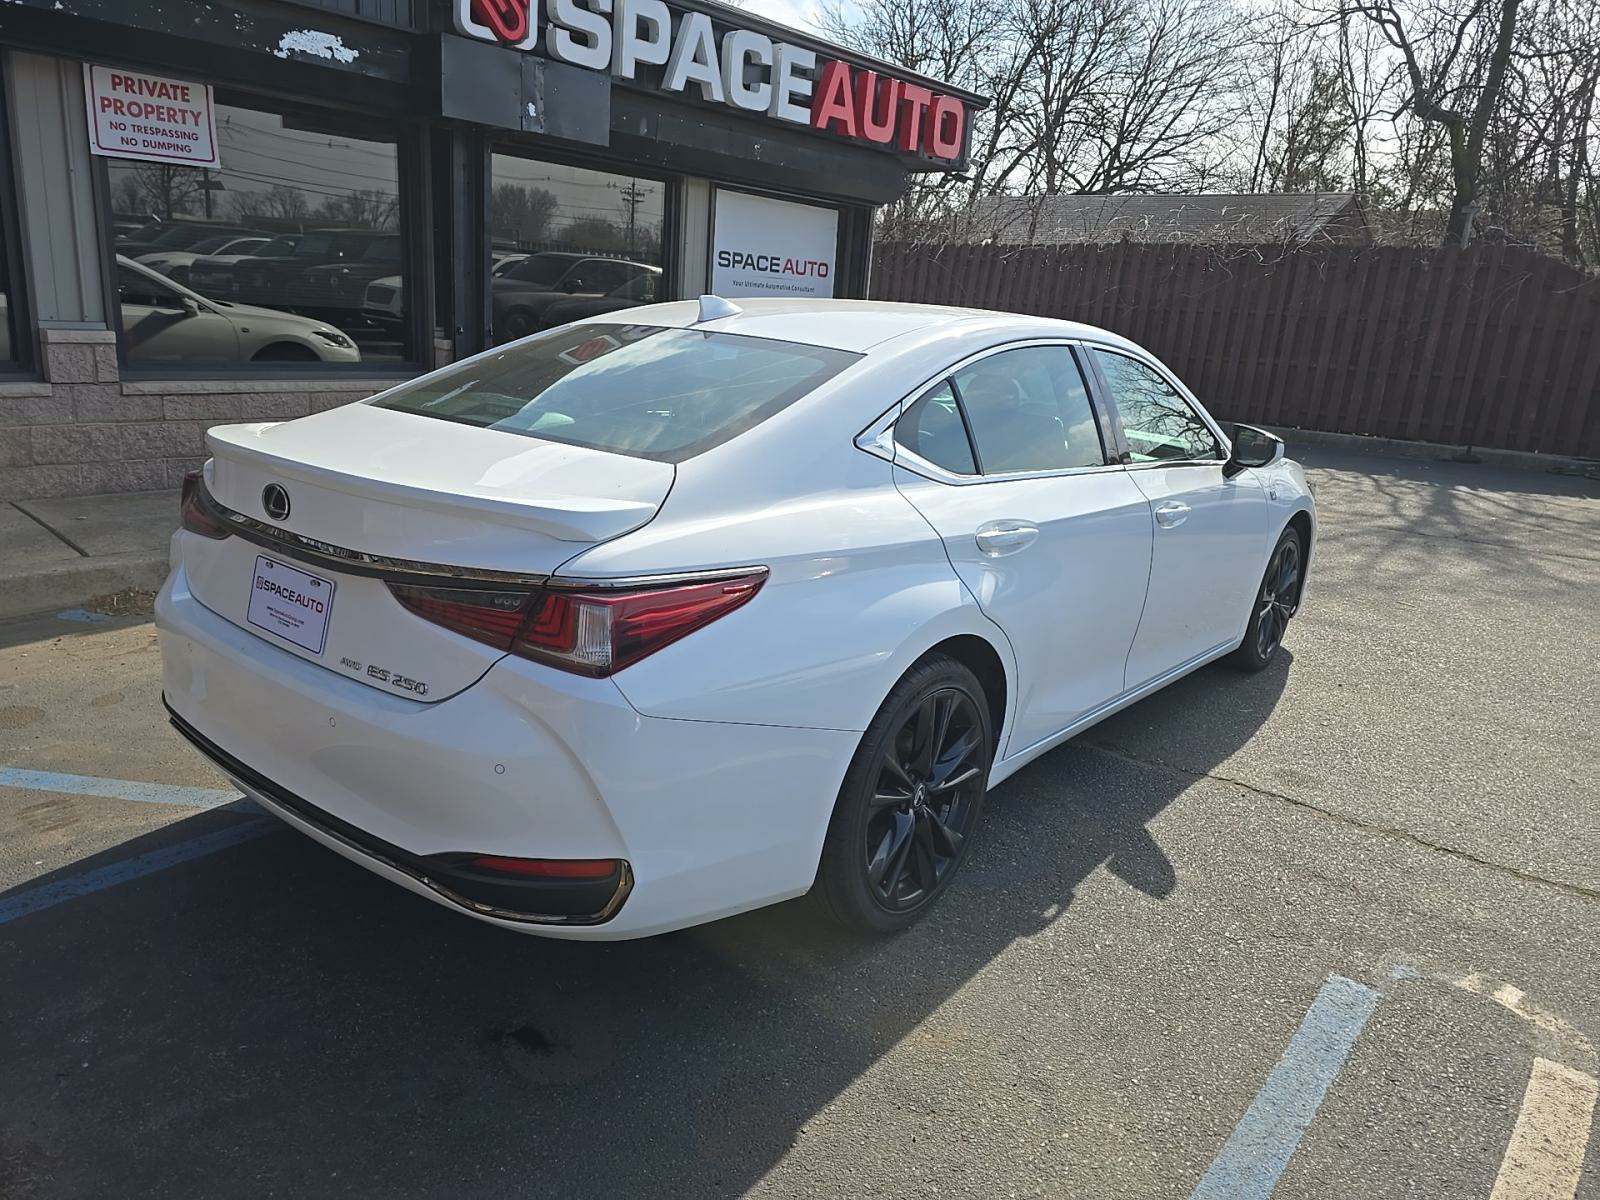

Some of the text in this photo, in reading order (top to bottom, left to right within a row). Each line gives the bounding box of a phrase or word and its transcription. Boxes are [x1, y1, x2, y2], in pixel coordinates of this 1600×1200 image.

[111, 73, 190, 103] PRIVATE
[100, 95, 202, 127] PROPERTY
[109, 120, 199, 141] NO TRESPASSING
[120, 136, 192, 153] NO DUMPING
[744, 280, 765, 289] Ultimate
[367, 664, 391, 682] ES
[392, 673, 428, 695] 250
